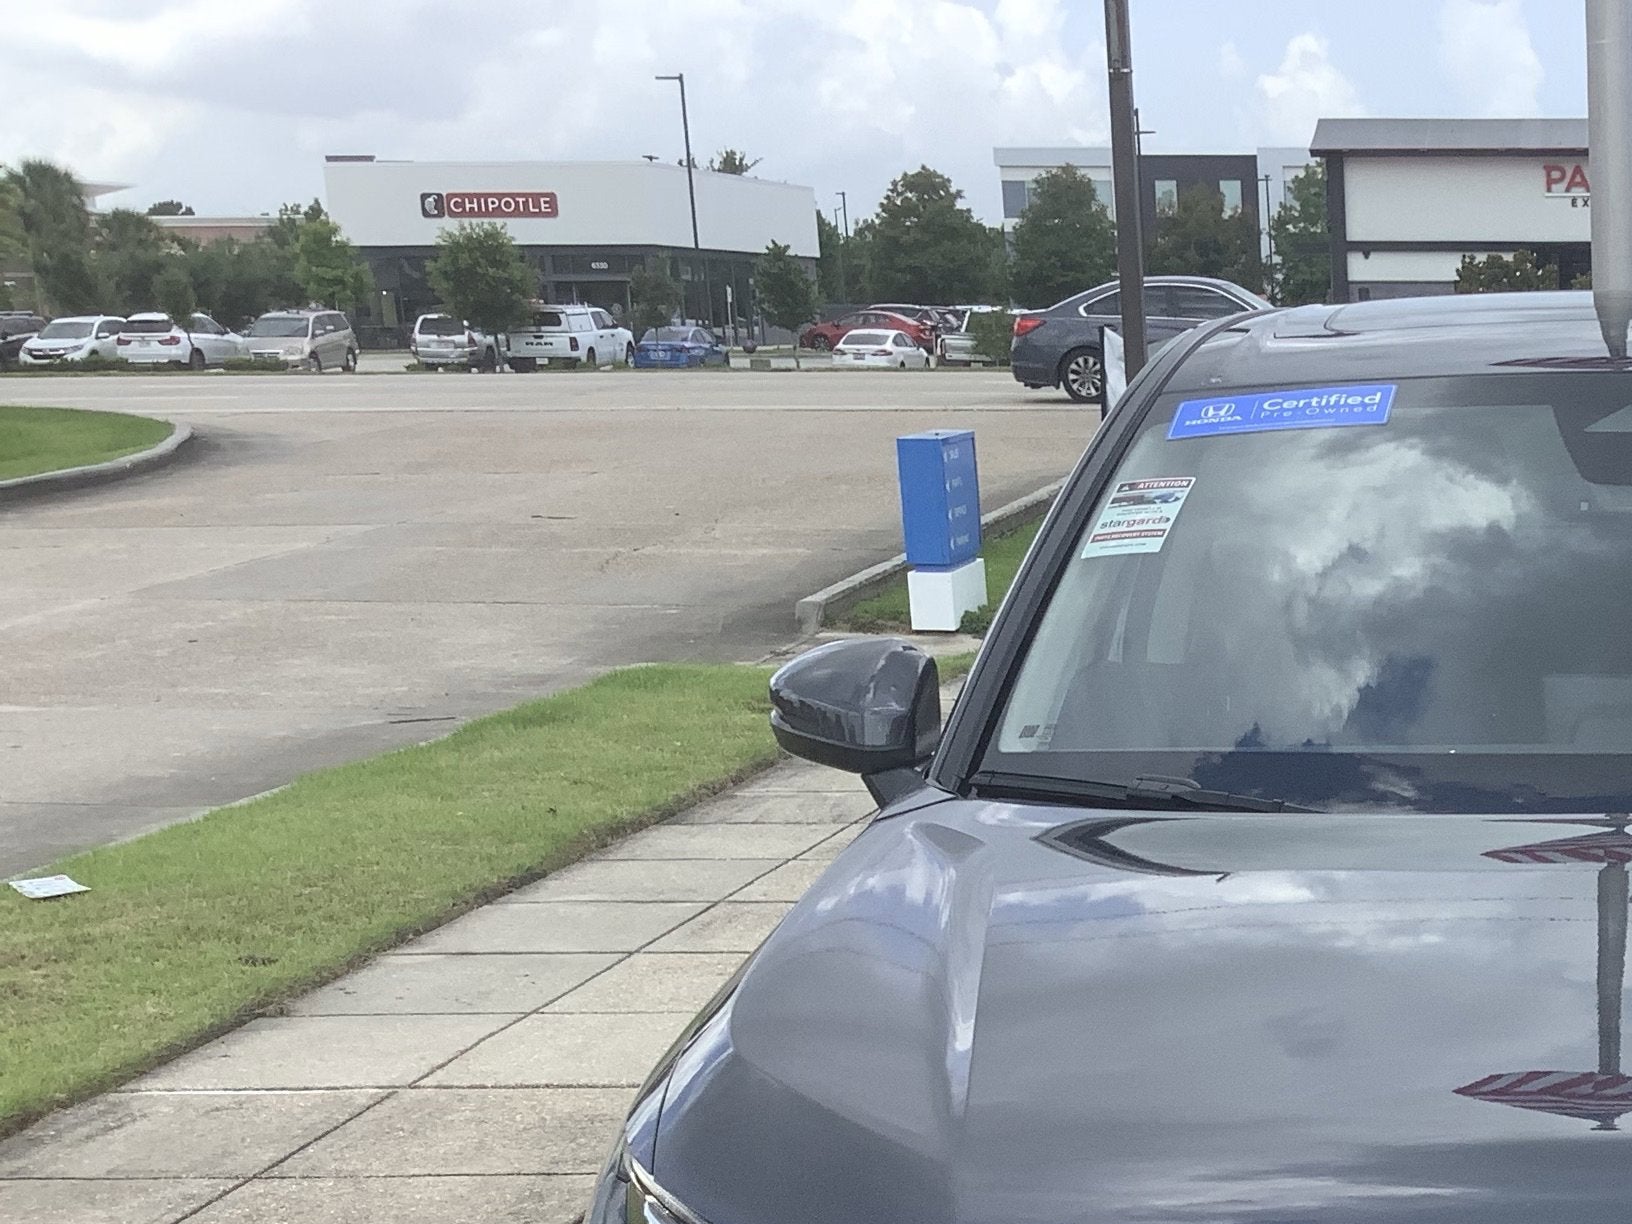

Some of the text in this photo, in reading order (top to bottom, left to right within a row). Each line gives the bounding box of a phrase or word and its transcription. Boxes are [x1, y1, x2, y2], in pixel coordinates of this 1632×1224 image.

[449, 197, 552, 212] CHIPOTLE
[1262, 391, 1382, 411] Certified
[1184, 415, 1243, 427] HONDA
[1137, 480, 1190, 489] ATTENTION
[1099, 516, 1164, 530] stargard
